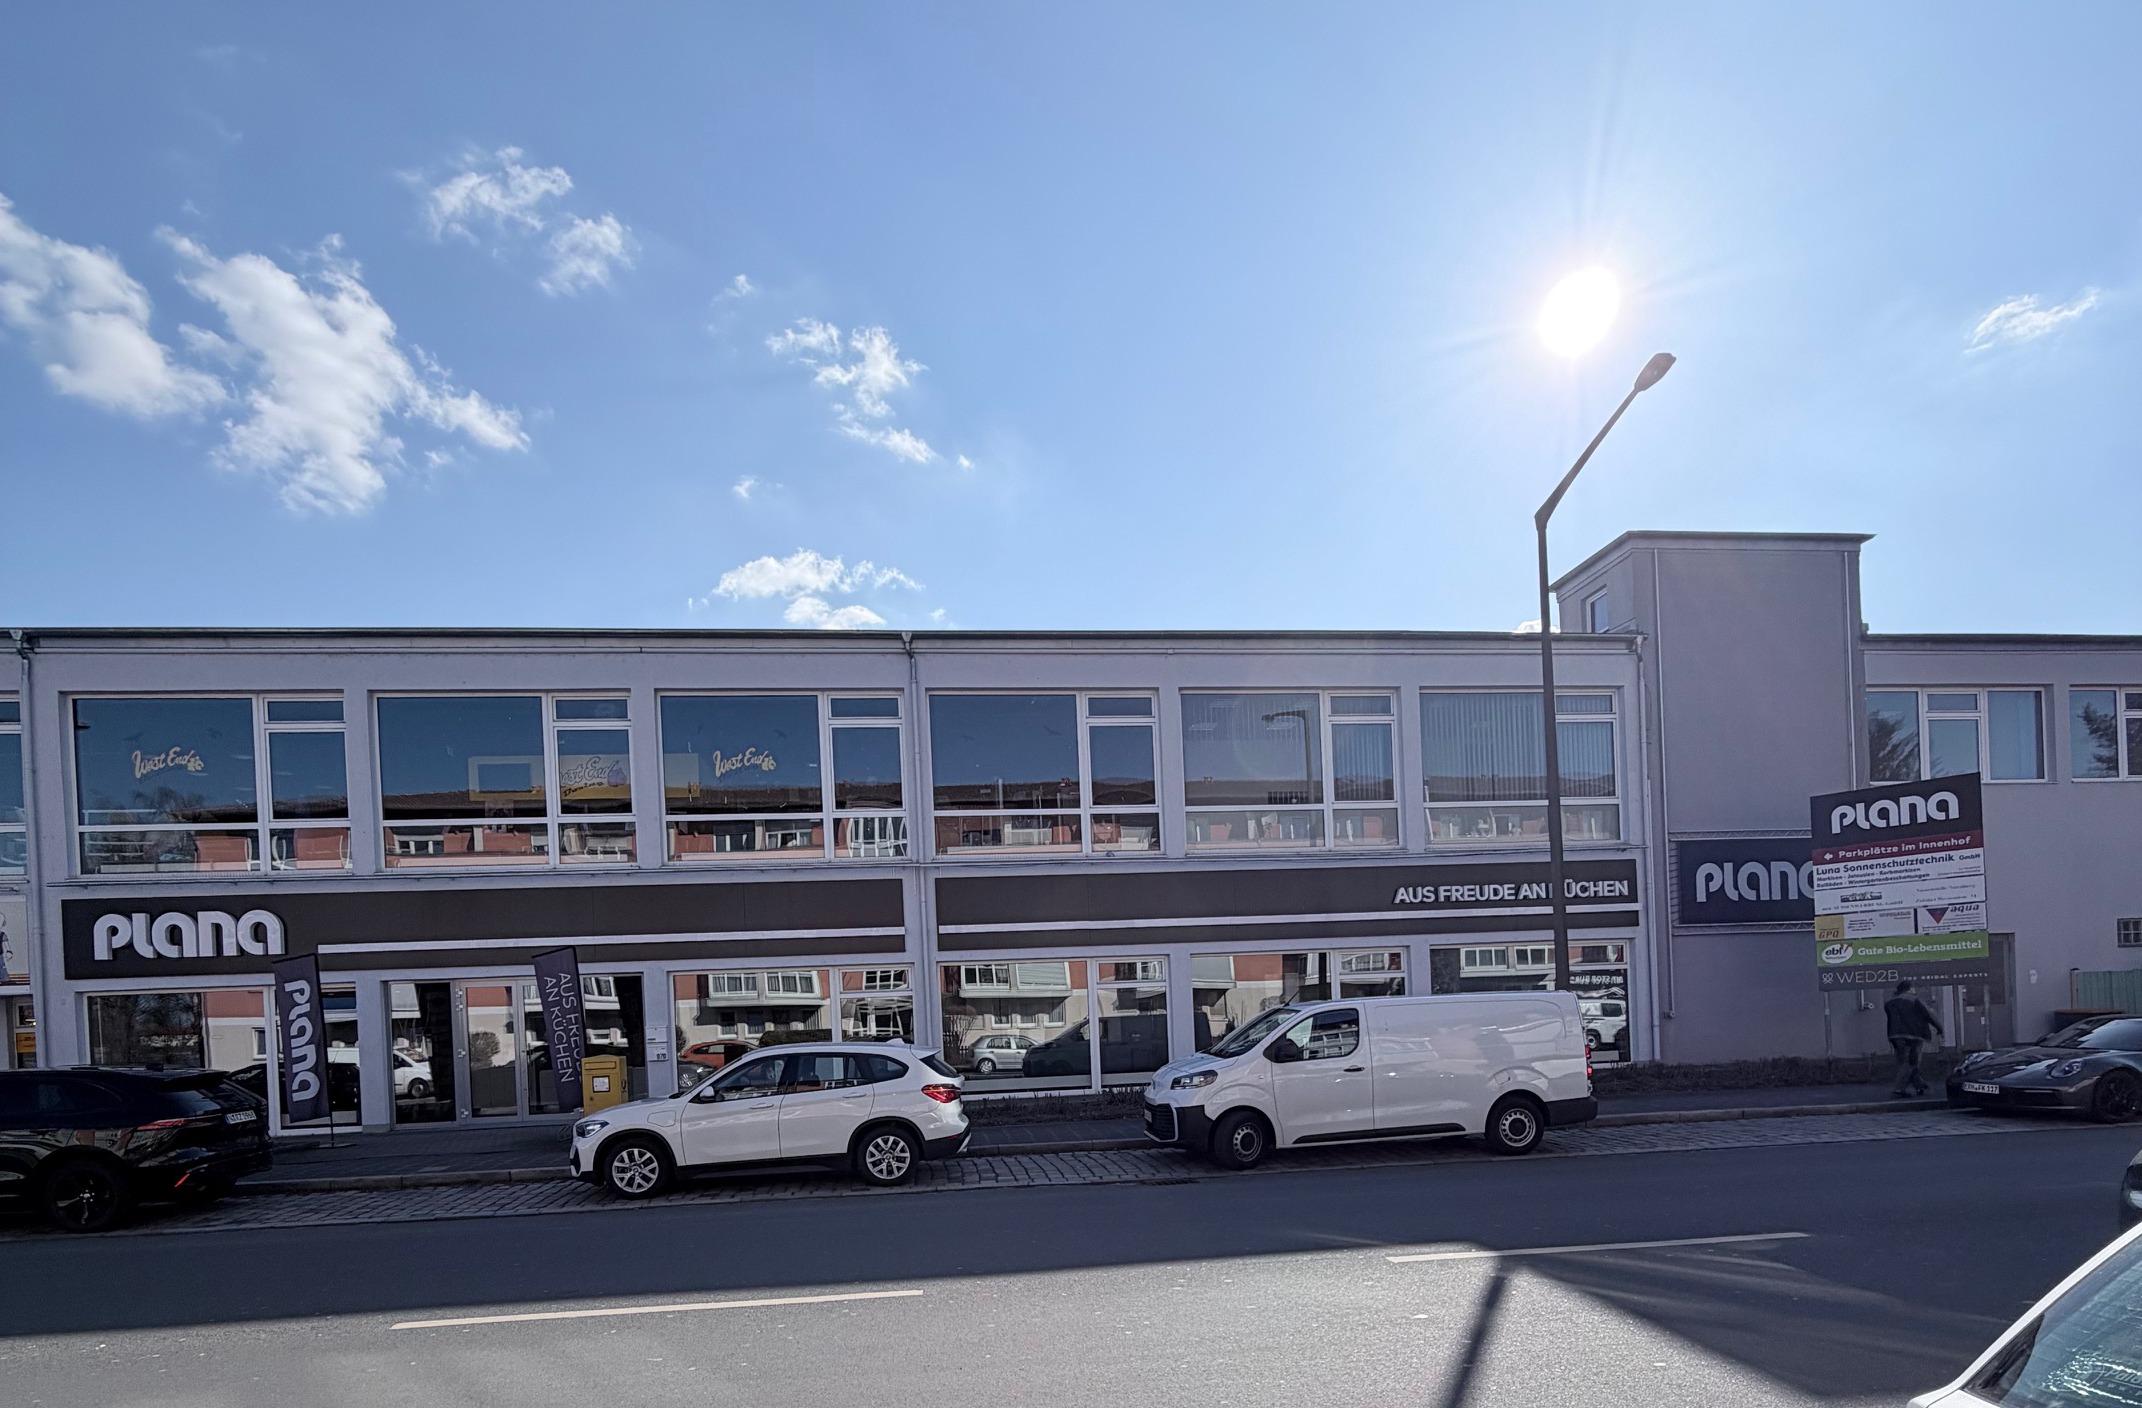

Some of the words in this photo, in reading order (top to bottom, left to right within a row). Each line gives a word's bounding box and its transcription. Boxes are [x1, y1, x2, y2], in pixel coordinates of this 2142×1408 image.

[132, 749, 166, 779] West
[166, 746, 196, 767] End
[713, 750, 744, 778] West
[744, 747, 769, 766] End
[1838, 845, 1899, 860] Parkplätze
[1901, 843, 1916, 852] im
[1919, 836, 1972, 850] Innenhof
[1816, 866, 1841, 876] Luna
[1843, 853, 1955, 873] Sonnenschutztechnik
[1959, 853, 1981, 861] GmbH
[1816, 874, 1843, 882] Markisen
[1848, 871, 1875, 879] Jalousien
[1393, 886, 1436, 904] AUS
[1438, 884, 1516, 903] FREUDE
[1517, 883, 1547, 899] AN
[1549, 879, 1629, 898] ÜCHEN
[1950, 904, 1980, 913] aqua
[1858, 947, 1884, 956] Gute
[1886, 940, 1983, 954] Bio-Lebensmittel
[1836, 969, 1899, 984] WED2B
[543, 976, 560, 1002] AN
[559, 972, 577, 1009] AUS
[550, 1007, 575, 1083] KÜCHEN
